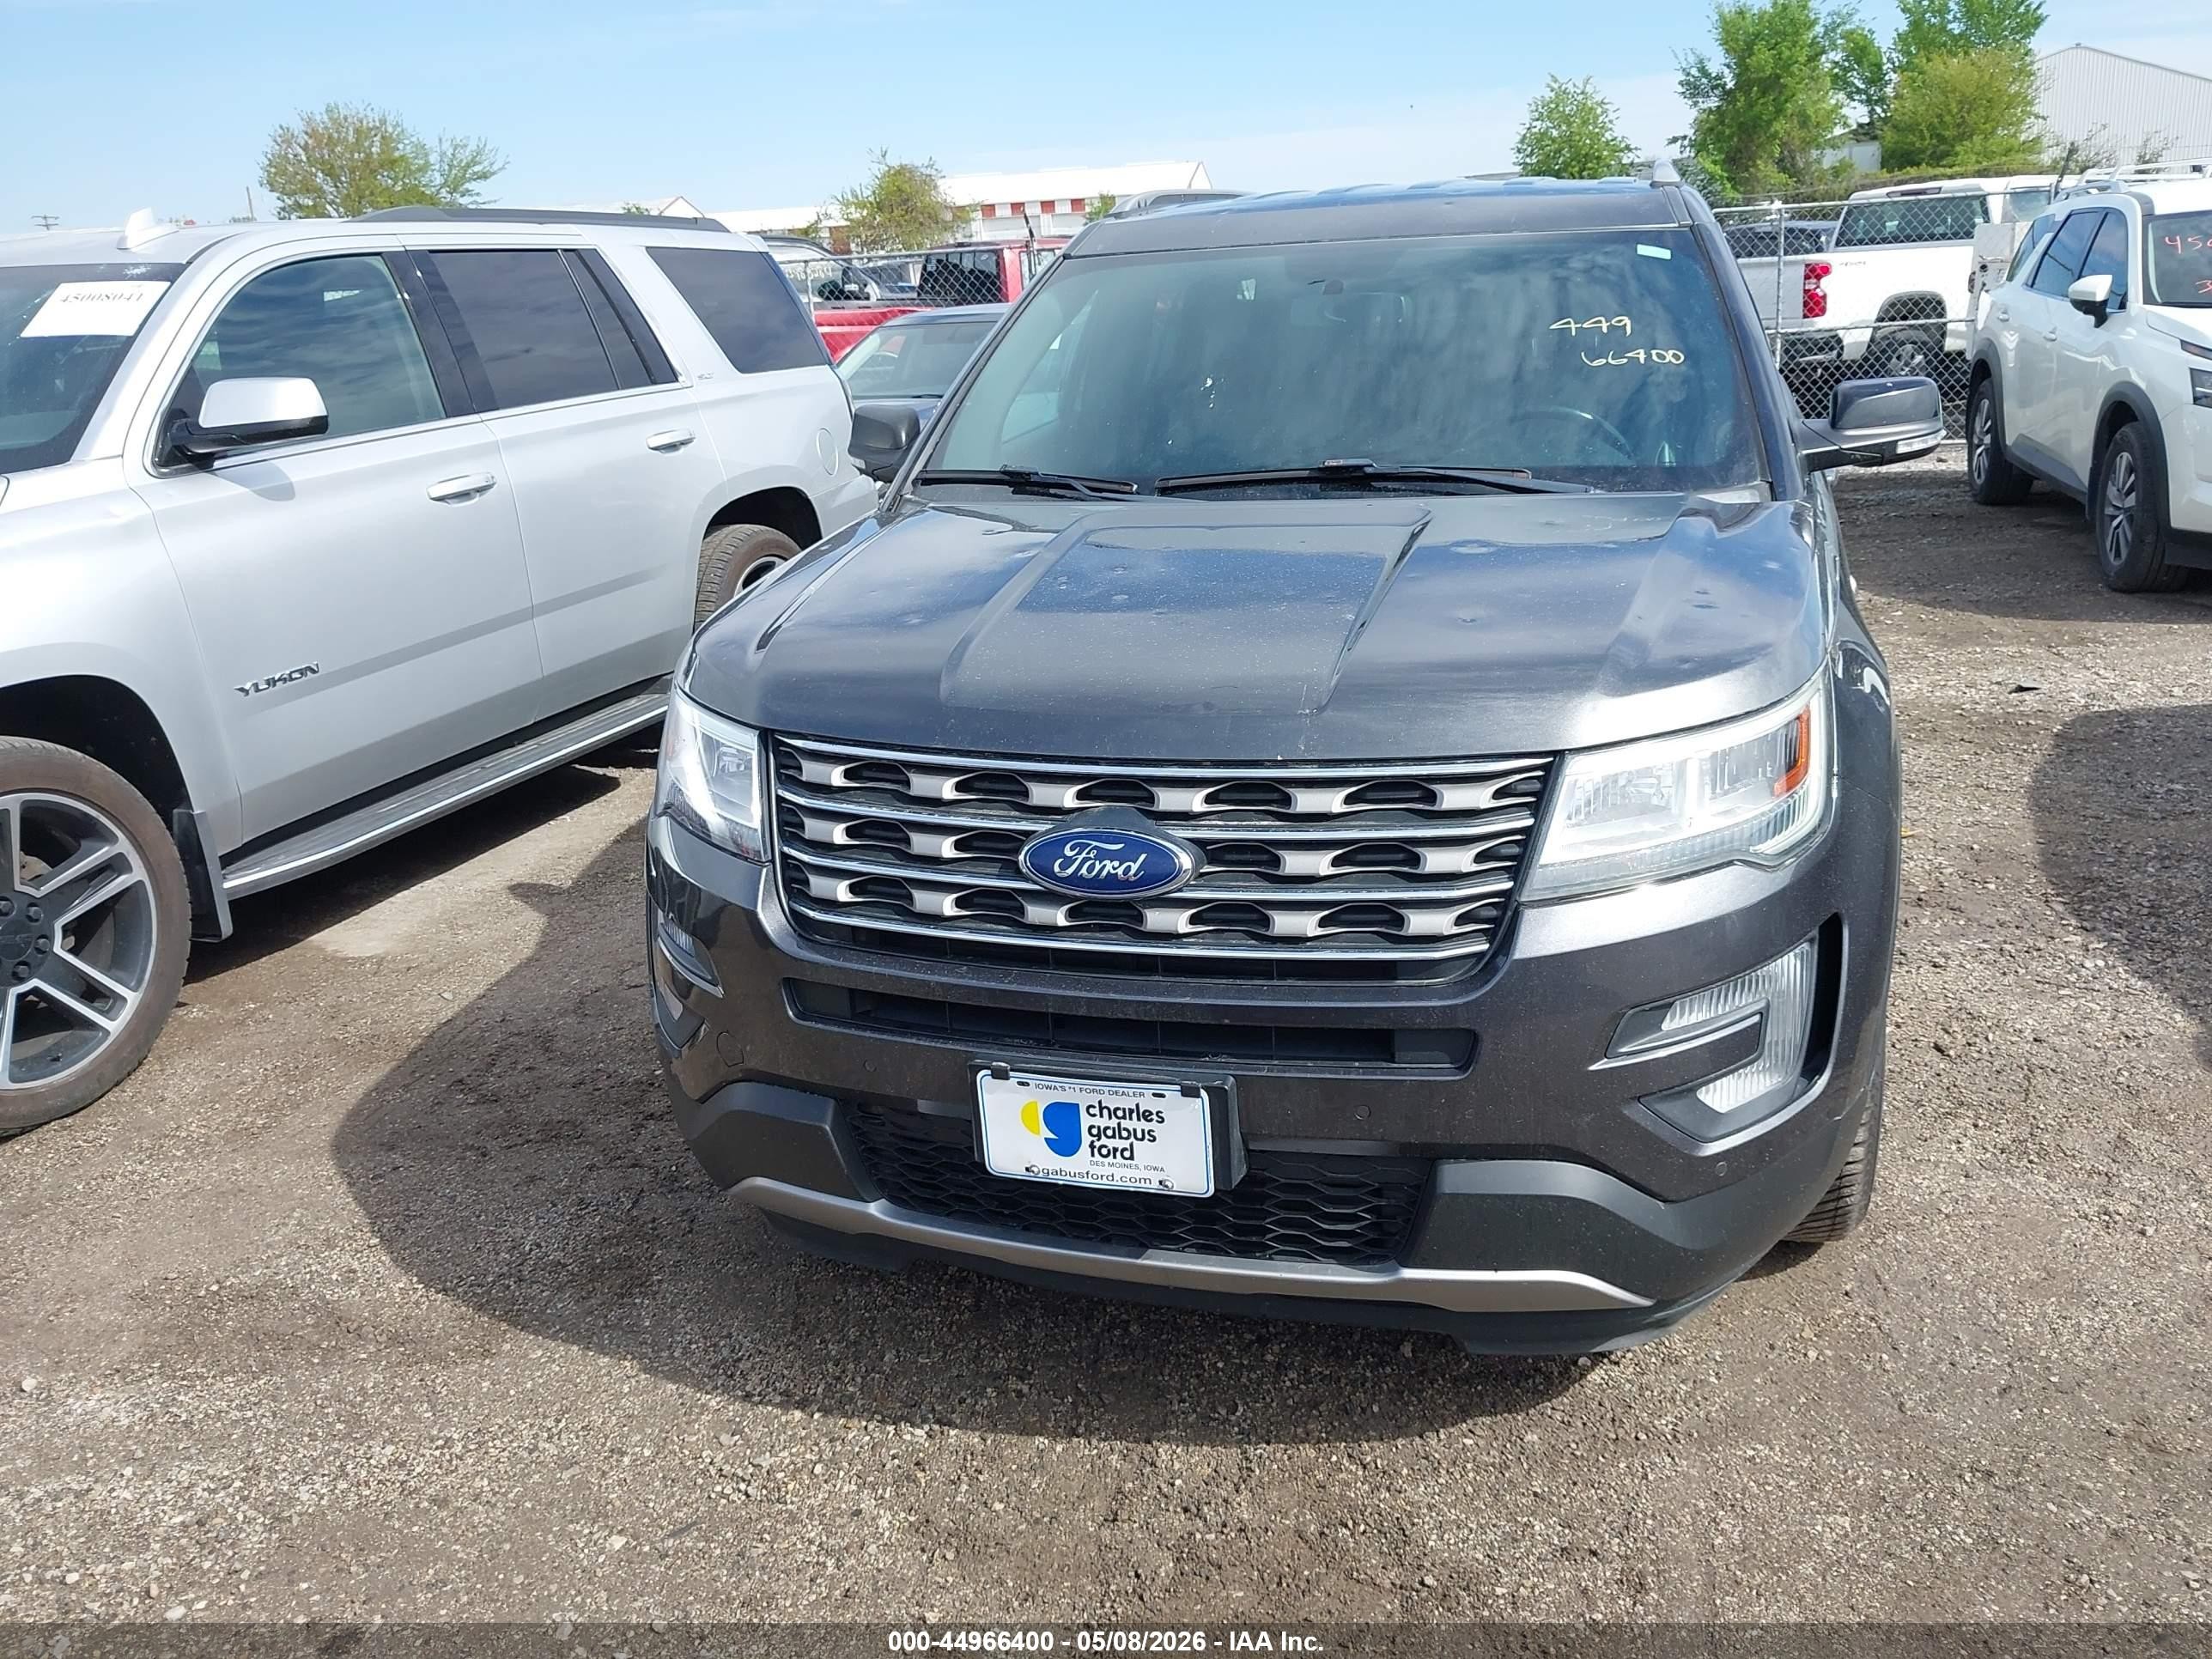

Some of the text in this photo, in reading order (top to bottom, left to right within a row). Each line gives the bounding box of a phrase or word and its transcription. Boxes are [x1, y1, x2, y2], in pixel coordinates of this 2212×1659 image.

[1548, 315, 1632, 337] 449
[1580, 349, 1686, 367] 66400
[234, 660, 320, 697] YUKON
[1053, 839, 1148, 881] Ford
[1034, 1082, 1067, 1092] IOWA'S
[1079, 1086, 1106, 1096] FORD
[1108, 1089, 1146, 1098] DEALER
[1085, 1098, 1165, 1124] charles
[1087, 1121, 1157, 1143] gabus
[1088, 1140, 1134, 1161] ford
[1041, 1166, 1152, 1187] gabusford.com
[1089, 1159, 1165, 1173] DES MOINES, IOWA
